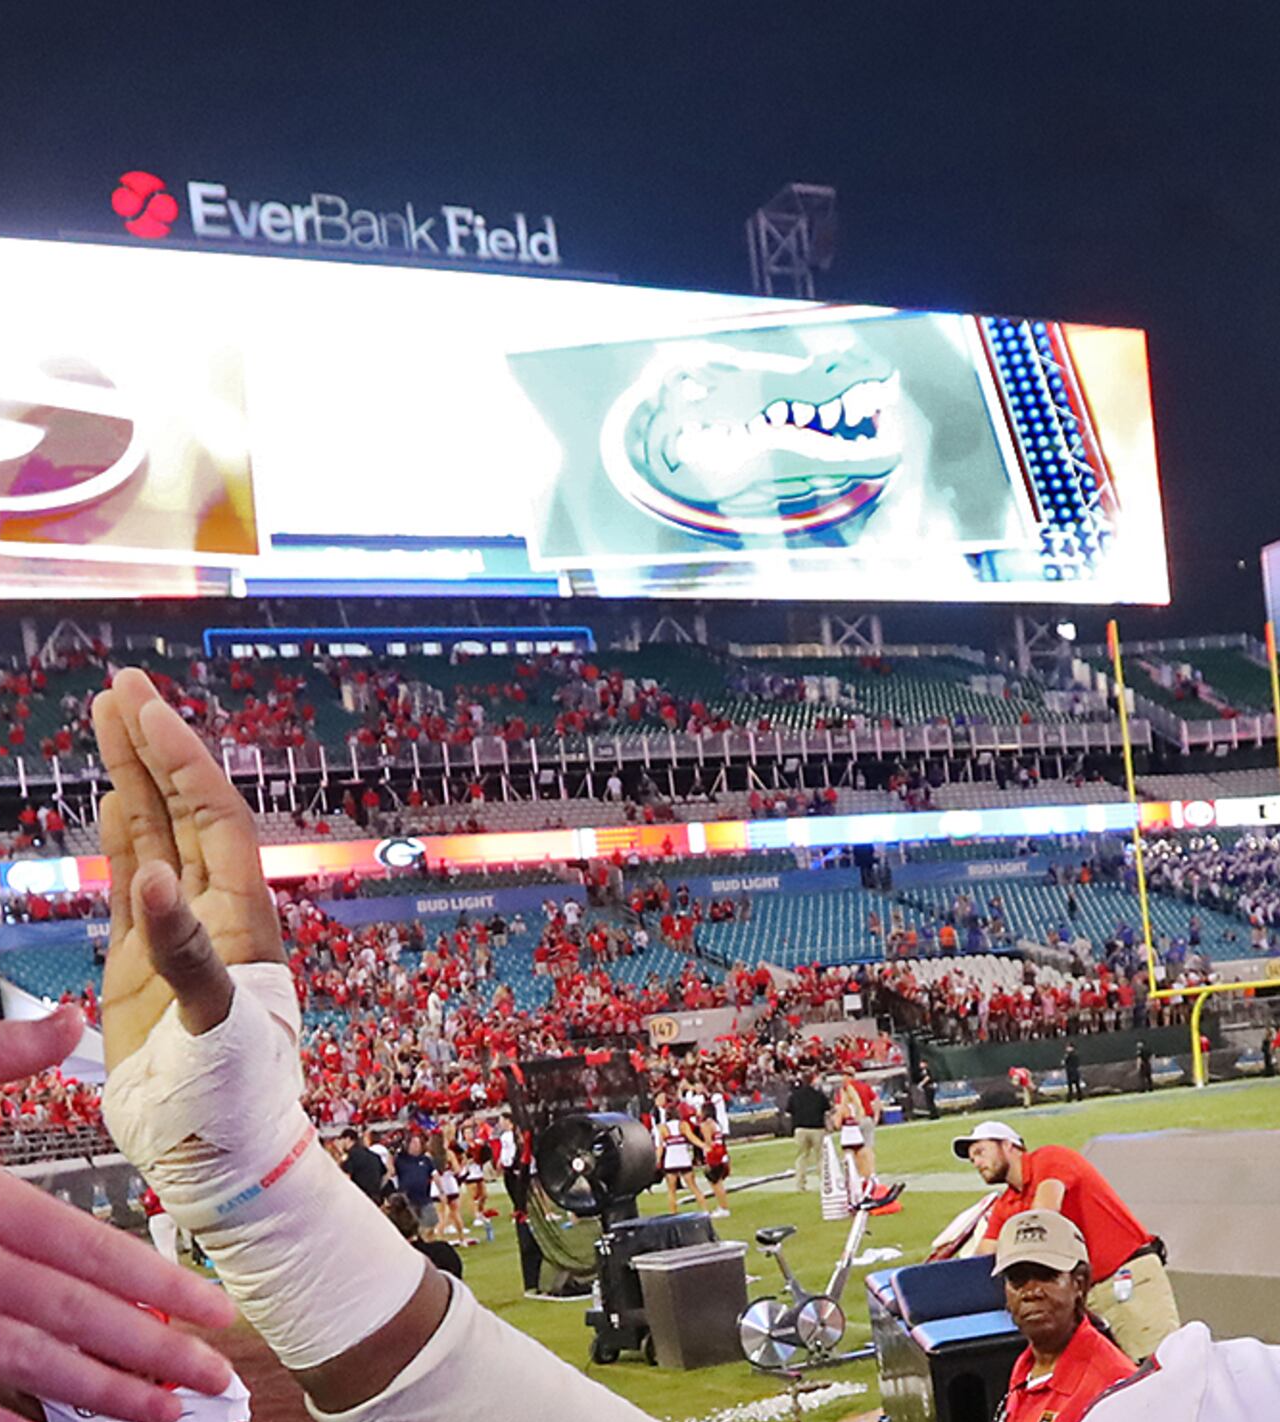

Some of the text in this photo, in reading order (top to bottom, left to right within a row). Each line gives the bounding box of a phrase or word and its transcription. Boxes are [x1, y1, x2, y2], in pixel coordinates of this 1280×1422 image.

[188, 181, 562, 265] EverBank Field
[967, 861, 1029, 876] BUD LIGHT
[711, 876, 781, 893] BUD LIGHT
[416, 895, 495, 913] BUD LIGHT
[86, 923, 110, 937] BU
[651, 1020, 674, 1037] 147
